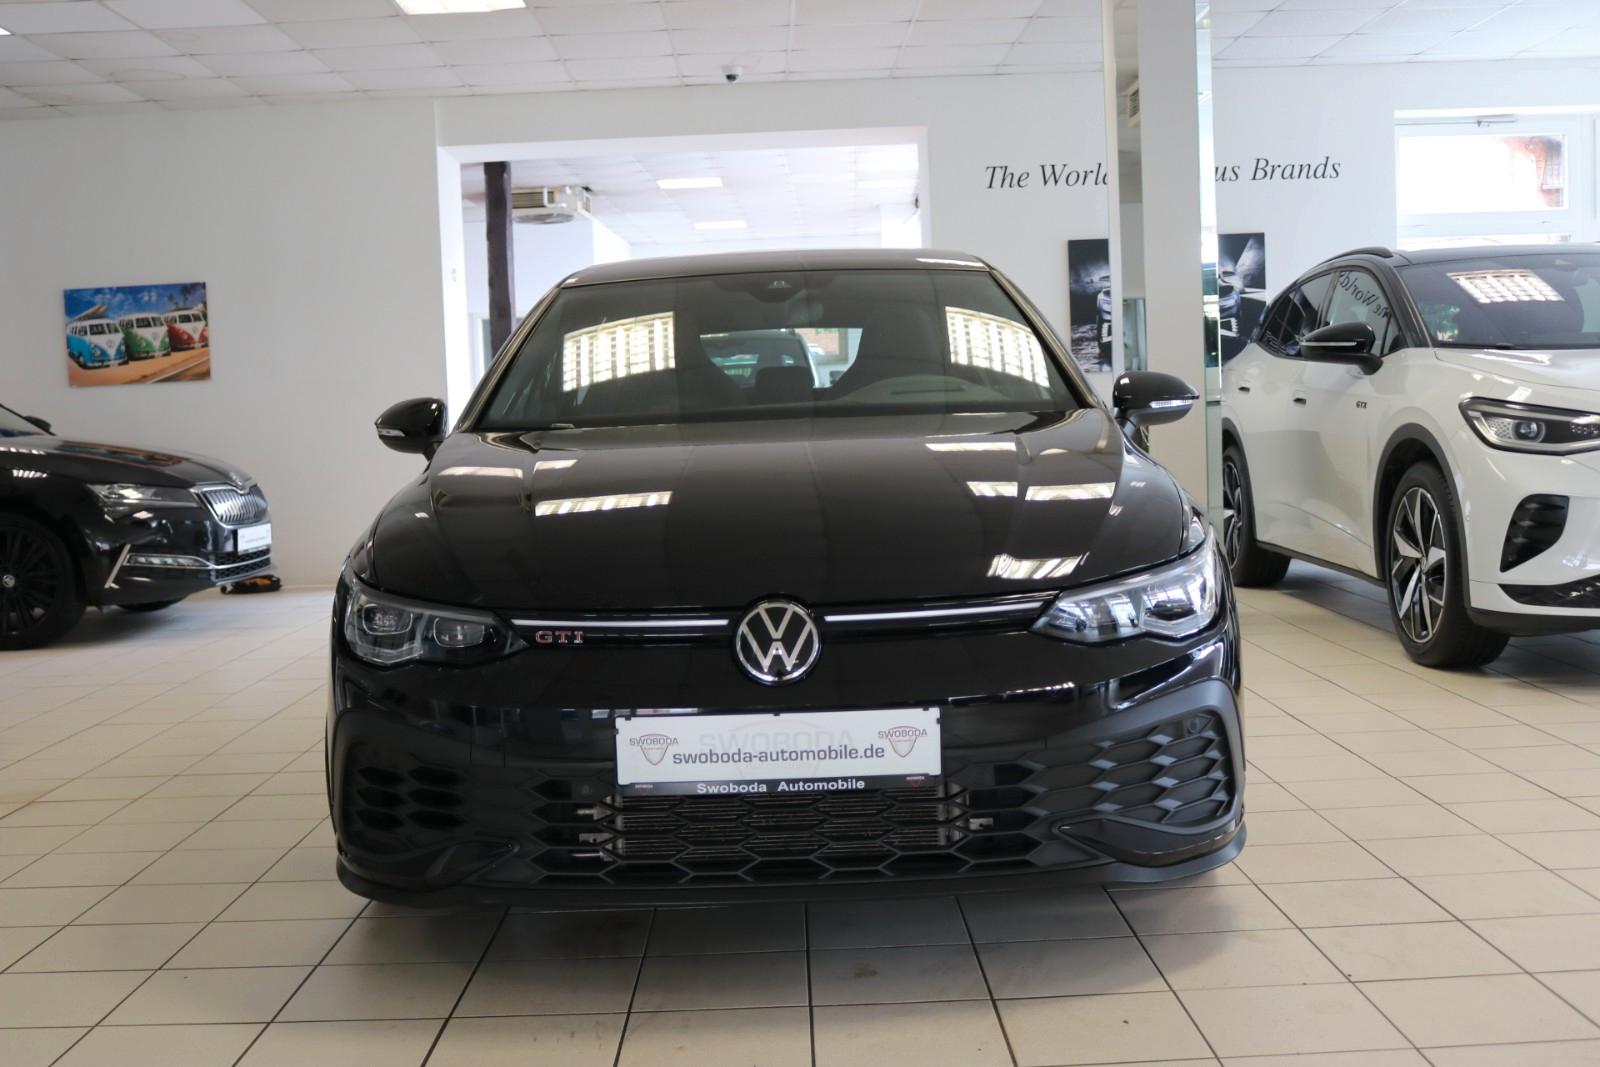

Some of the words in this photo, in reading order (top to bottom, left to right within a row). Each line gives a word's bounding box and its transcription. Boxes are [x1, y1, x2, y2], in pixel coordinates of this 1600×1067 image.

[985, 165, 1030, 188] The
[1249, 156, 1341, 181] Brands
[535, 630, 584, 644] GTI
[878, 728, 928, 739] SWOBODA
[629, 737, 679, 746] SWOBODA
[672, 743, 885, 765] swoboda-automobile.de
[696, 782, 767, 794] Swoboda
[777, 778, 865, 792] Automobile
